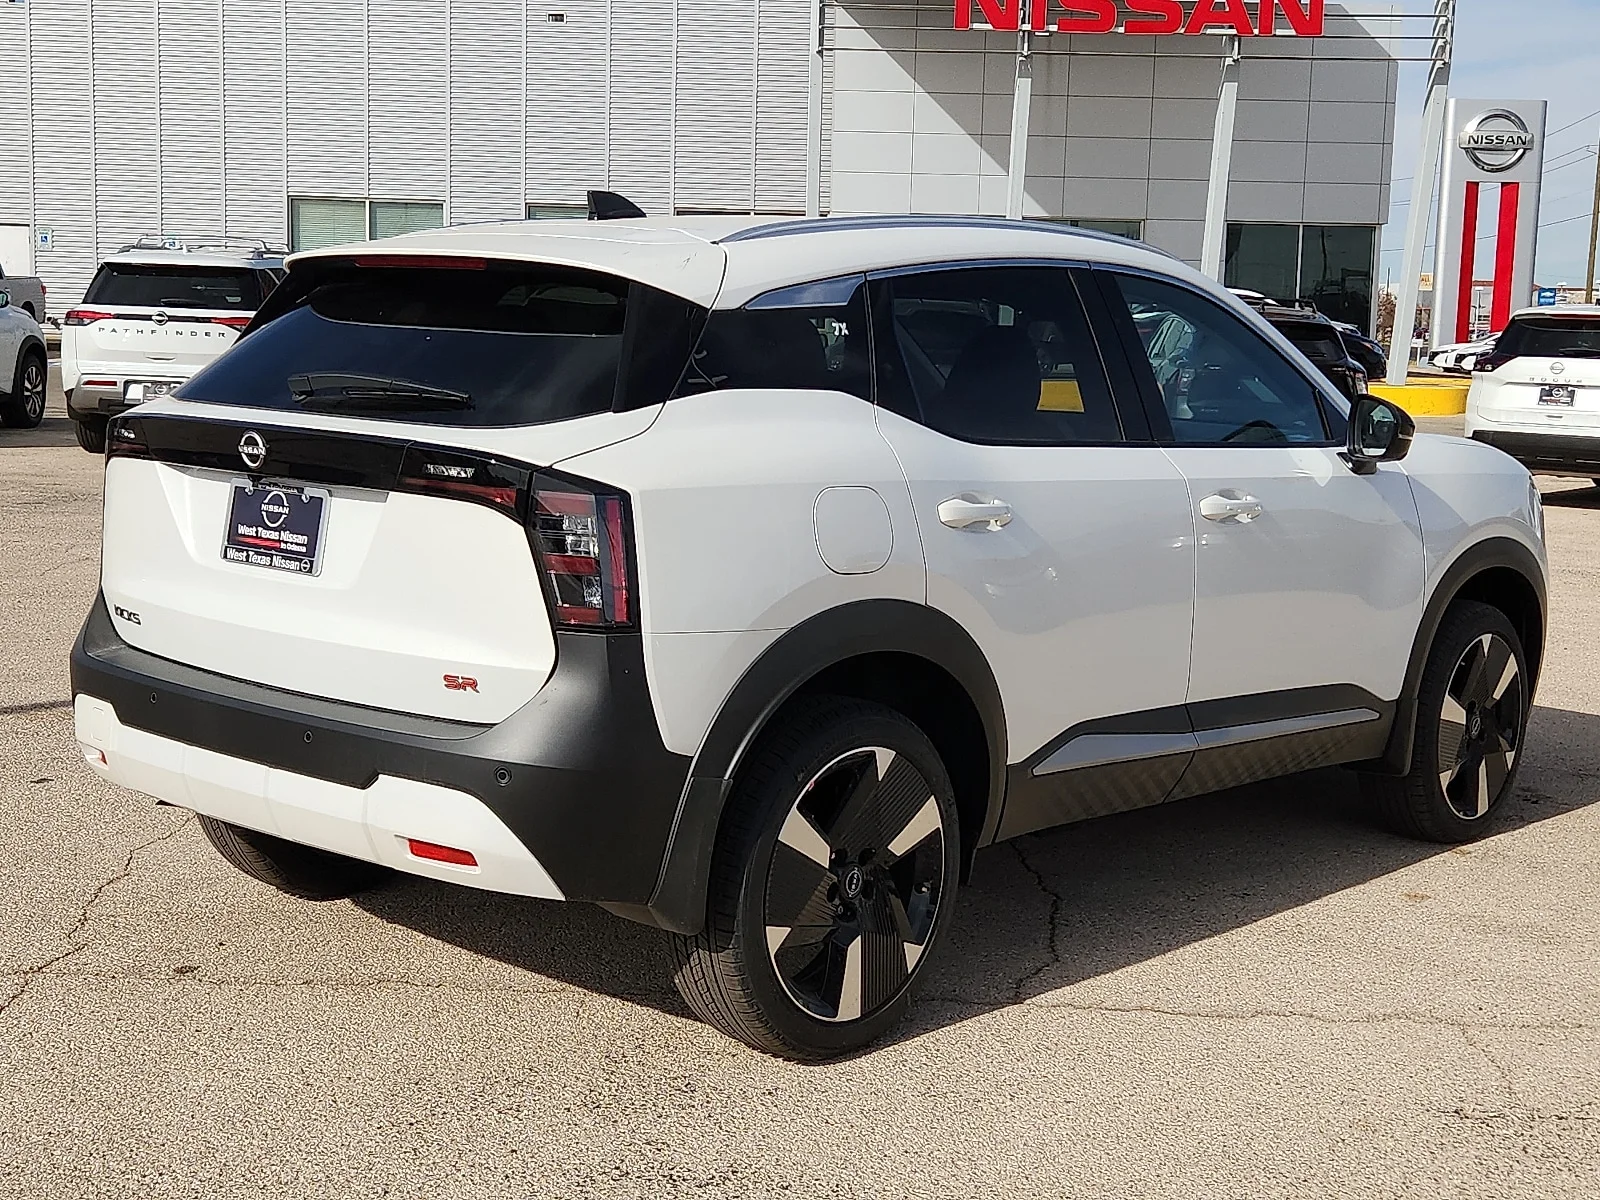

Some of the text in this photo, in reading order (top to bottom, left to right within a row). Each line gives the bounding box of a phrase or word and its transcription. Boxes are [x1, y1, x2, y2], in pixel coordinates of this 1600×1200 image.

[954, 0, 1325, 36] NISSAN
[1467, 134, 1528, 146] NISSAN
[98, 326, 227, 338] PATHFINDER
[260, 503, 290, 515] NISSAN
[237, 523, 308, 545] West Texas Nissan
[226, 547, 300, 571] West Texas Nissan
[442, 674, 481, 694] SR
